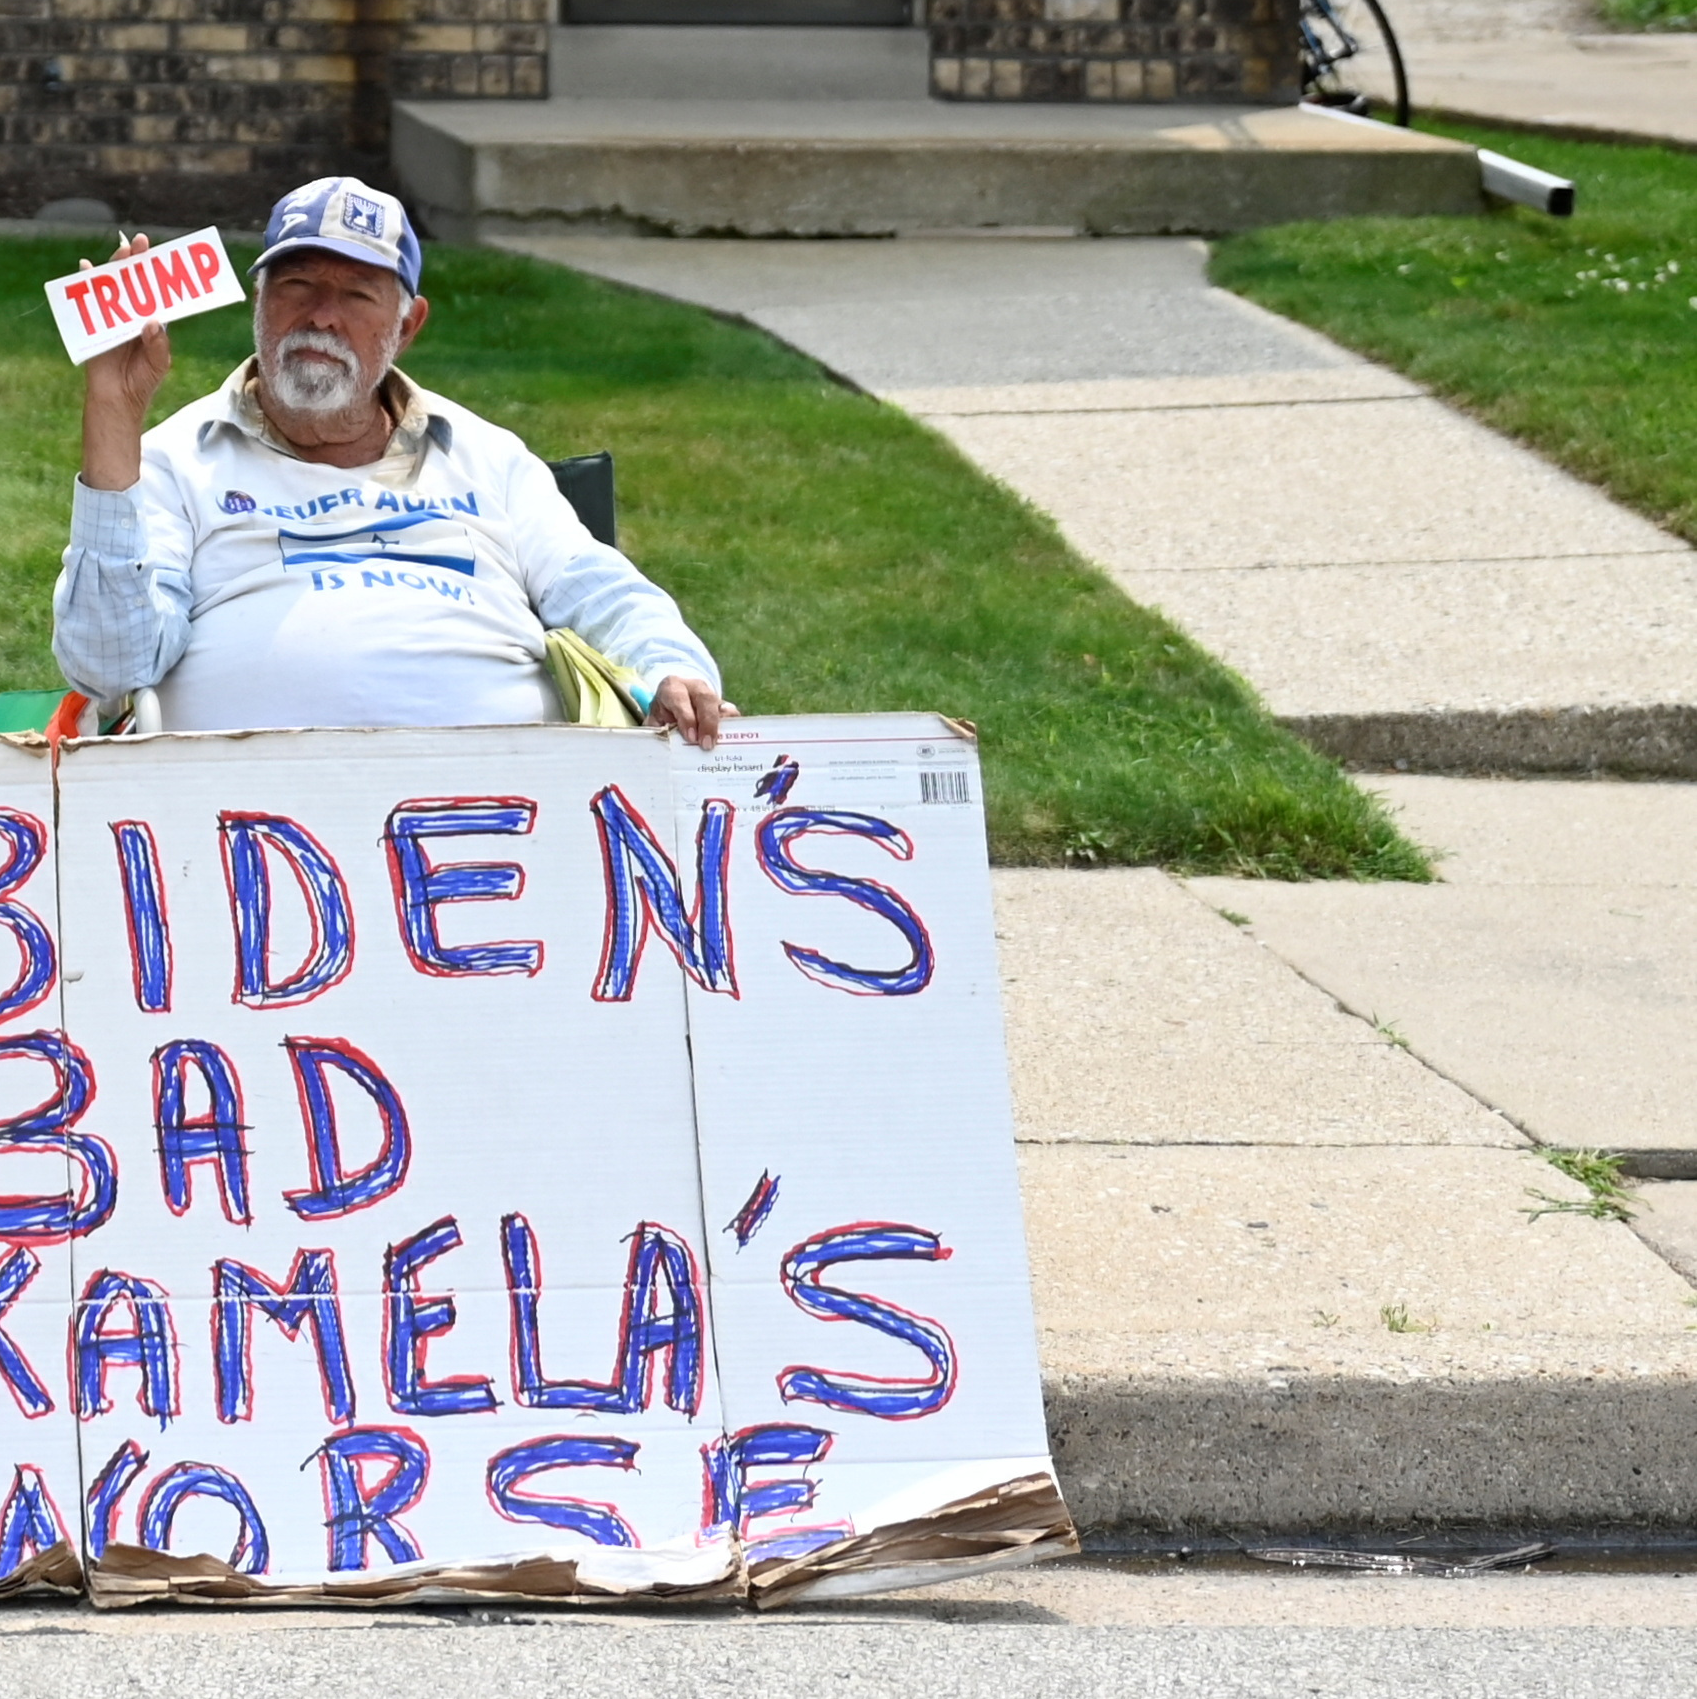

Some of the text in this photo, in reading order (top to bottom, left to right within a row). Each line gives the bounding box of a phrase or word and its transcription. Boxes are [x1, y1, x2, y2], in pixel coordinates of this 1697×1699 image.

[64, 242, 220, 336] TRUMP
[311, 571, 345, 591] IS
[697, 762, 764, 773] display board
